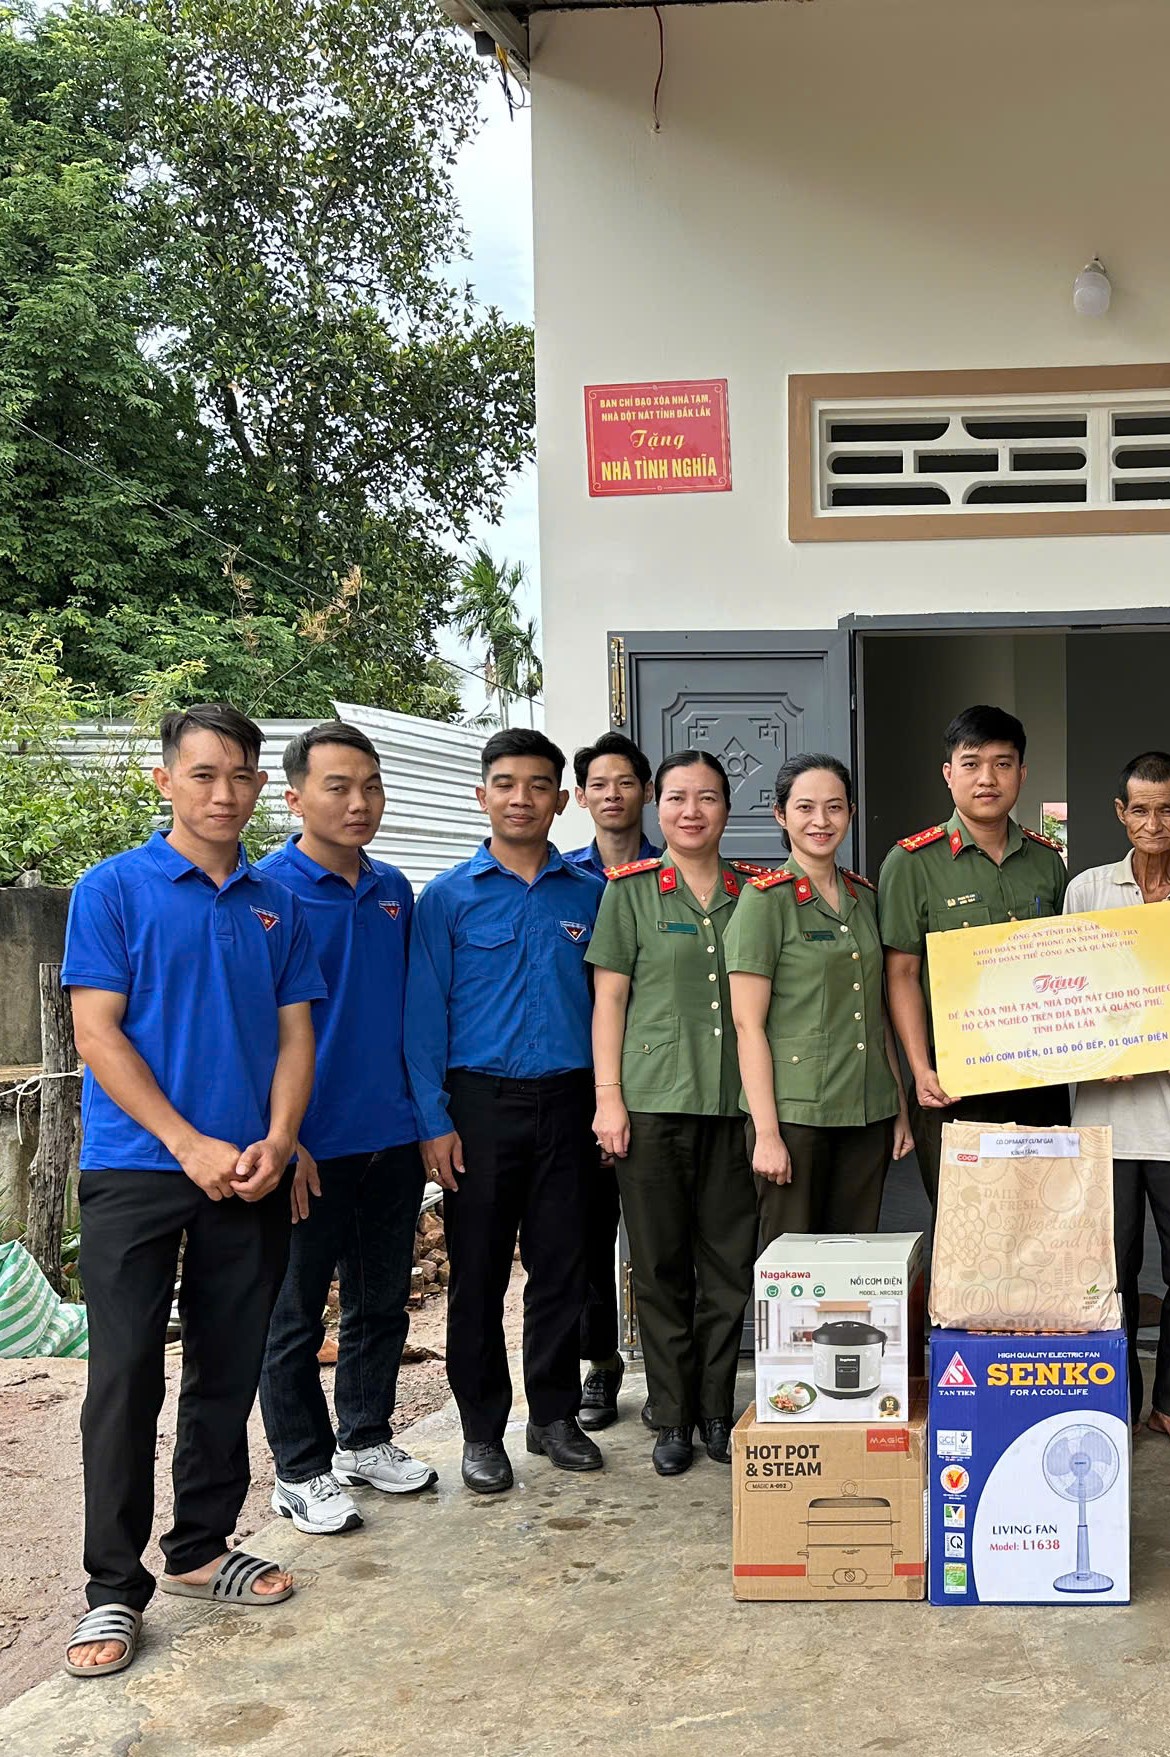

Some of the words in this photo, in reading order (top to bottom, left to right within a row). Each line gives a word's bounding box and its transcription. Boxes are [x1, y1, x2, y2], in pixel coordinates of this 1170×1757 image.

[600, 399, 617, 408] BAN
[635, 397, 651, 408] ĐẠO
[672, 393, 689, 405] NHÀ
[601, 411, 619, 422] NHÀ
[630, 429, 685, 450] Tặng
[601, 457, 632, 481] NHÀ
[634, 456, 668, 480] TÌNH
[672, 454, 718, 478] NGHĨA
[1065, 946, 1075, 954] AN
[1032, 974, 1089, 995] Tặng
[1105, 989, 1125, 1000] CHO
[966, 1057, 977, 1066] 01
[1043, 1047, 1054, 1055] 01
[1109, 1038, 1120, 1047] 01
[999, 1200, 1040, 1211] FRESH
[1050, 1229, 1083, 1248] and
[760, 1270, 811, 1281] Nagakawa
[865, 1277, 882, 1286] CƠM
[986, 1362, 1116, 1387] SENKO
[1068, 1388, 1089, 1396] LIFE
[745, 1445, 782, 1460] HOT
[785, 1444, 820, 1460] POT
[745, 1462, 759, 1477] &
[762, 1461, 822, 1477] STEAM
[992, 1524, 1032, 1535] LIVING
[1035, 1524, 1058, 1534] FAN
[989, 1542, 1020, 1551] Model:
[1022, 1539, 1060, 1551] L1638
